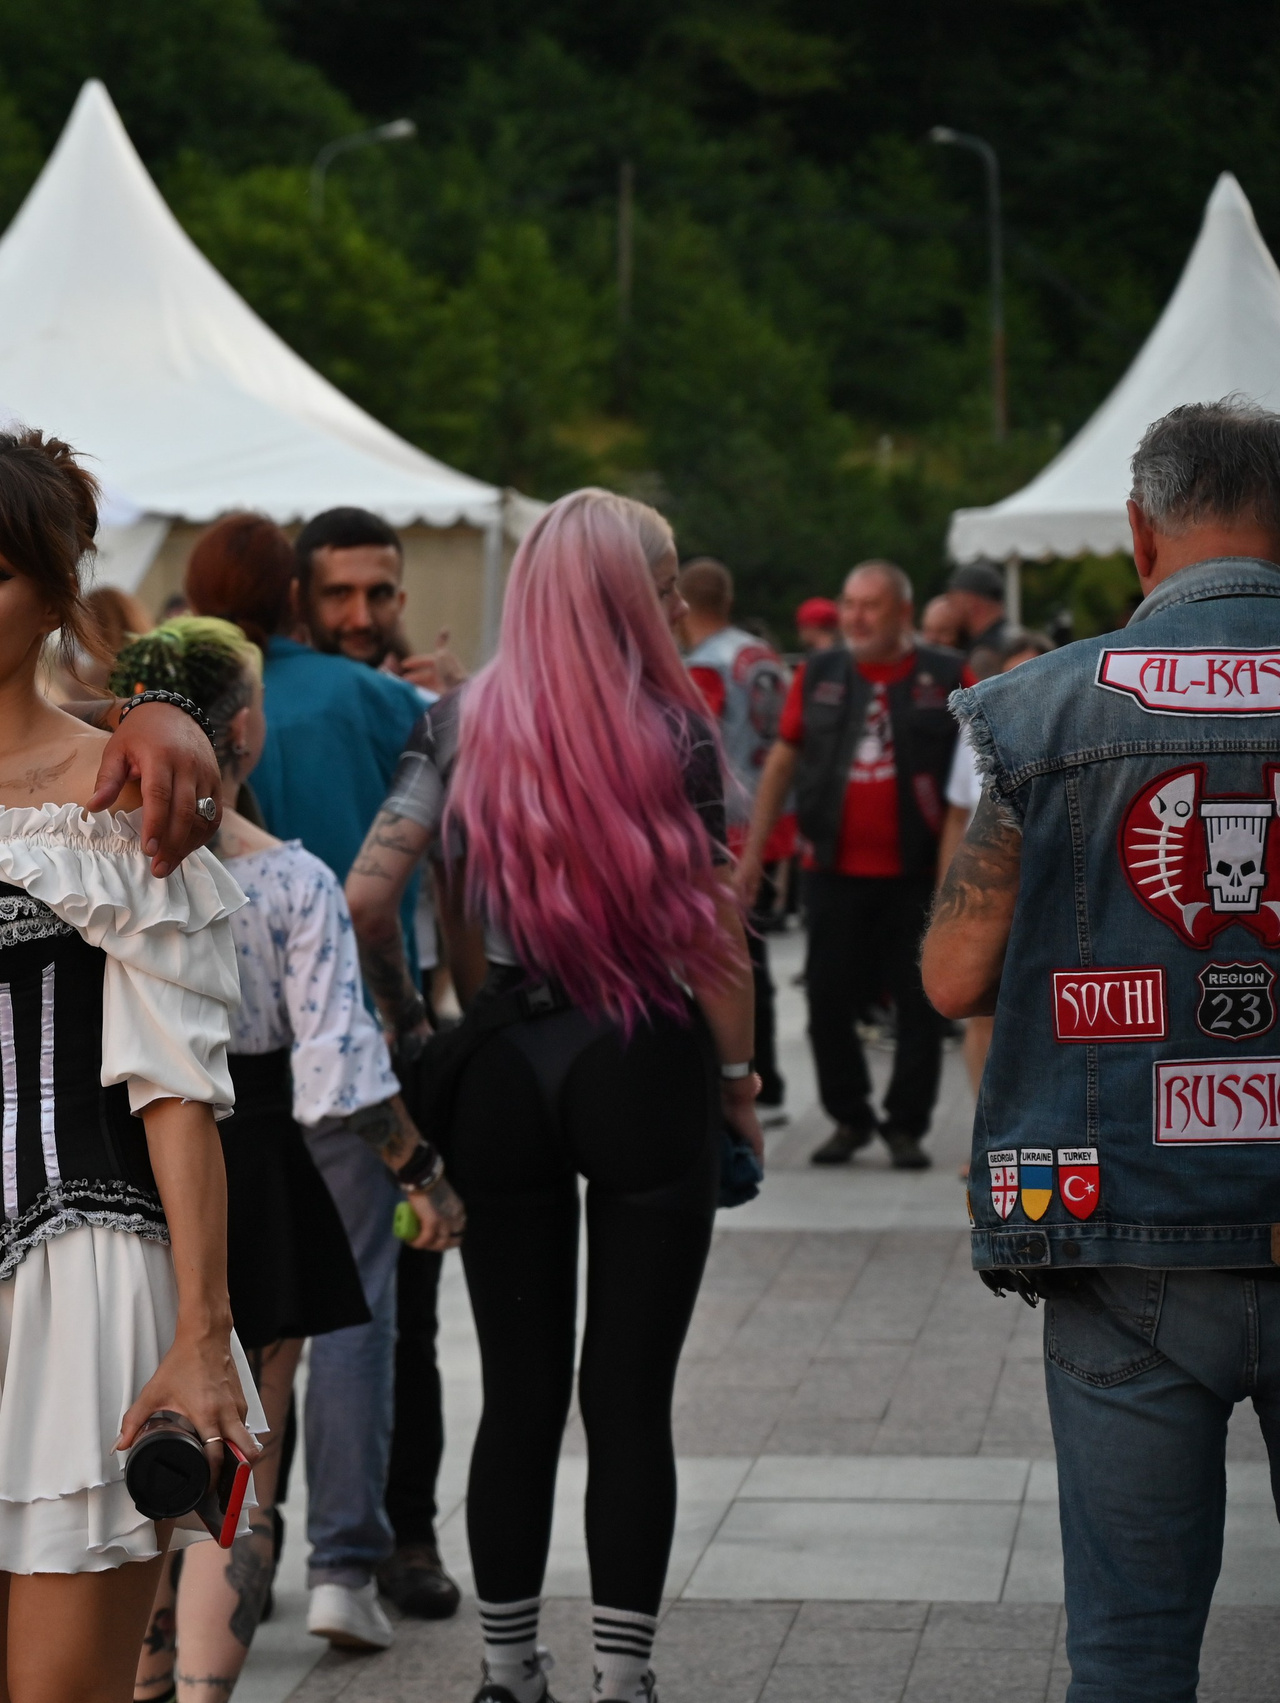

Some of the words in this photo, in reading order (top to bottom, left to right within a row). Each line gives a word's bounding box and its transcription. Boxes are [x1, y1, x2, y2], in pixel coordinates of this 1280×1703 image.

[1208, 972, 1265, 985] REGION
[1061, 979, 1156, 1030] SOCHI
[1210, 992, 1262, 1030] 23
[1164, 1073, 1280, 1133] RUSSI
[989, 1153, 1015, 1163] GEORGIA
[1022, 1151, 1052, 1162] UKRAINE
[1063, 1151, 1092, 1161] TURKEY
